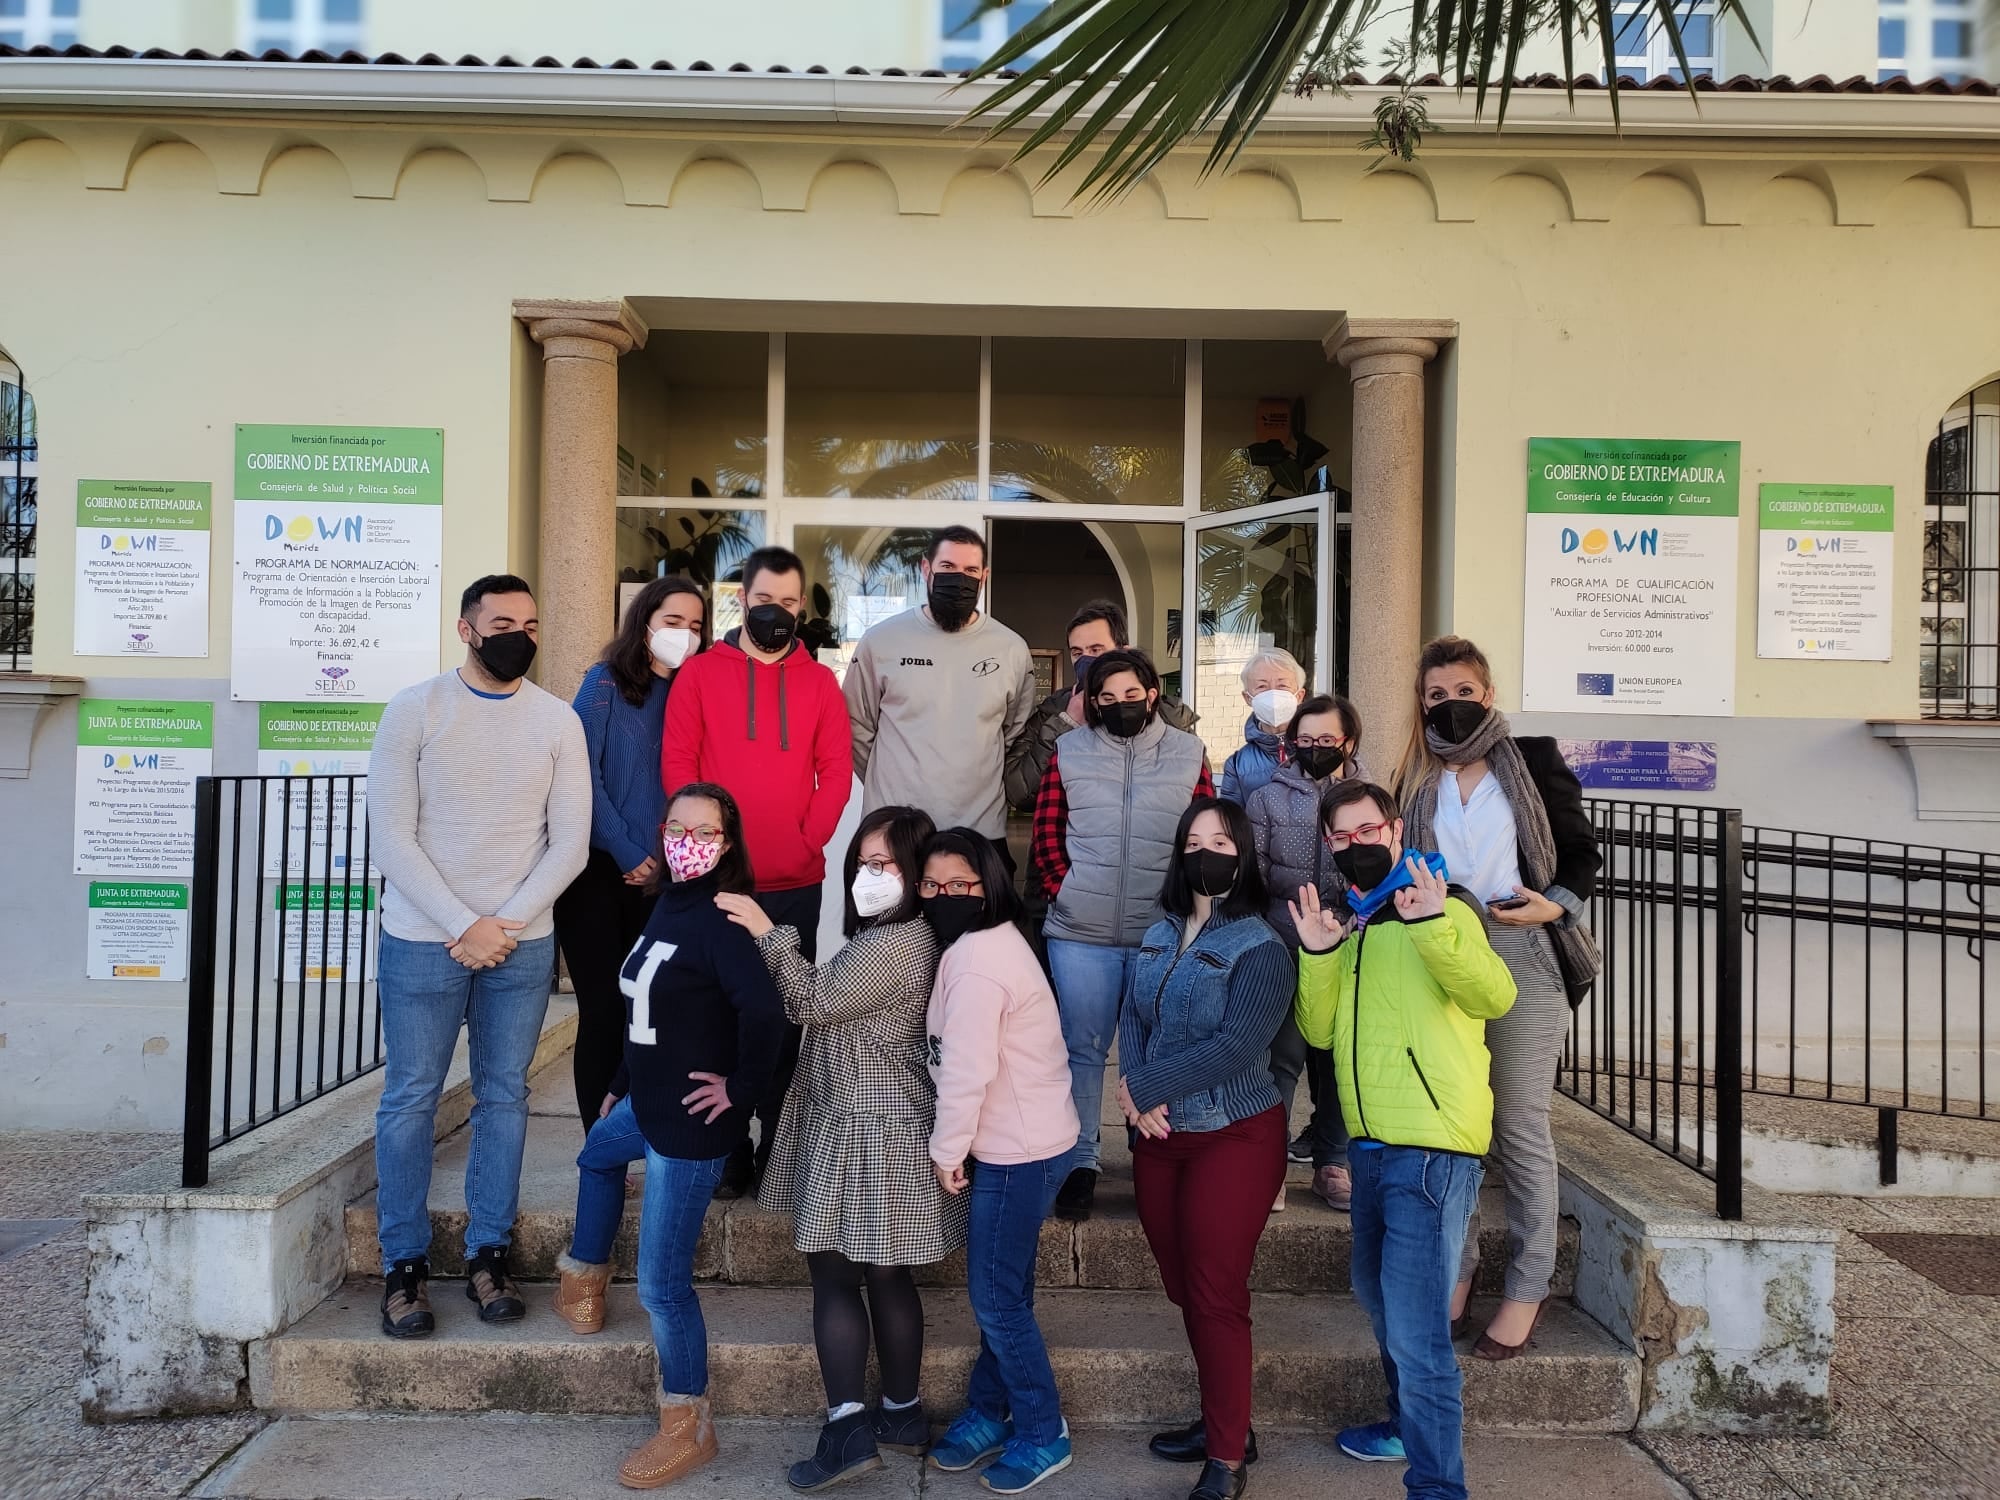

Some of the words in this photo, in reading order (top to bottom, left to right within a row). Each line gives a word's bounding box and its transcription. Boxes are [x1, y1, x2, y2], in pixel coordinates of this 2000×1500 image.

[292, 434, 327, 444] Inversión
[330, 435, 369, 445] financiada
[372, 438, 386, 448] por
[1584, 450, 1620, 460] Inversión
[1622, 451, 1670, 461] cofinanciada
[1672, 453, 1688, 463] por
[248, 453, 311, 471] GOBIERNO
[315, 455, 329, 471] DE
[333, 455, 430, 474] EXTREMADURA
[1544, 464, 1608, 481] GOBIERNO
[1611, 465, 1625, 481] DE
[1630, 466, 1726, 484] EXTREMADURA
[260, 482, 303, 493] Consejería
[322, 483, 344, 493] Salud
[359, 484, 388, 494] Política
[393, 485, 417, 495] Social
[85, 497, 126, 508] GOBIERNO
[141, 499, 203, 510] EXTREMADURA
[1556, 491, 1601, 503] Consejería
[1622, 492, 1663, 502] Educación
[1679, 494, 1711, 503] Cultura
[1769, 501, 1810, 512] GOBIERNO
[1813, 502, 1824, 512] DE
[1826, 503, 1885, 513] EXTREMADURA
[265, 514, 362, 543] DOWN
[101, 534, 157, 551] DOWN
[1562, 528, 1658, 556] DOWN
[255, 558, 311, 569] PROGRAMA
[314, 559, 327, 569] DE
[330, 559, 420, 571] NORMALIZACIÓN:
[243, 571, 282, 582] Programa
[299, 573, 348, 583] Orientación
[359, 573, 395, 584] Inserción
[399, 575, 430, 585] Laboral
[1550, 577, 1608, 588] PROGRAMA
[1616, 579, 1629, 588] DE
[1637, 579, 1714, 590] CUALIFICACIÓN
[250, 586, 289, 597] Programa
[306, 587, 353, 597] Información
[375, 588, 413, 598] Población
[1577, 593, 1644, 603] PROFESIONAL
[1651, 594, 1687, 604] INICIAL
[259, 597, 303, 607] Promoción
[330, 599, 358, 610] Imagen
[375, 600, 412, 610] Personas
[318, 610, 371, 621] discapacidad.
[1604, 609, 1641, 618] Servicios
[314, 624, 335, 633] Año:
[338, 624, 355, 633] 2014
[1600, 629, 1623, 638] Curso
[1625, 629, 1663, 638] 2012-2014
[289, 637, 325, 648] Importe:
[1588, 643, 1622, 652] Inversión:
[1625, 644, 1650, 652] 60.000
[317, 651, 353, 661] Financia:
[315, 680, 355, 691] SEPAD
[88, 717, 117, 729] JUNTA
[121, 718, 132, 728] DE
[134, 718, 203, 730] EXTREMADURA
[268, 720, 308, 730] GOBIERNO
[322, 721, 378, 732] EXTREMADUR
[104, 754, 158, 769] DOWN
[97, 889, 118, 898] JUNTA
[131, 889, 180, 898] EXTREMADURA
